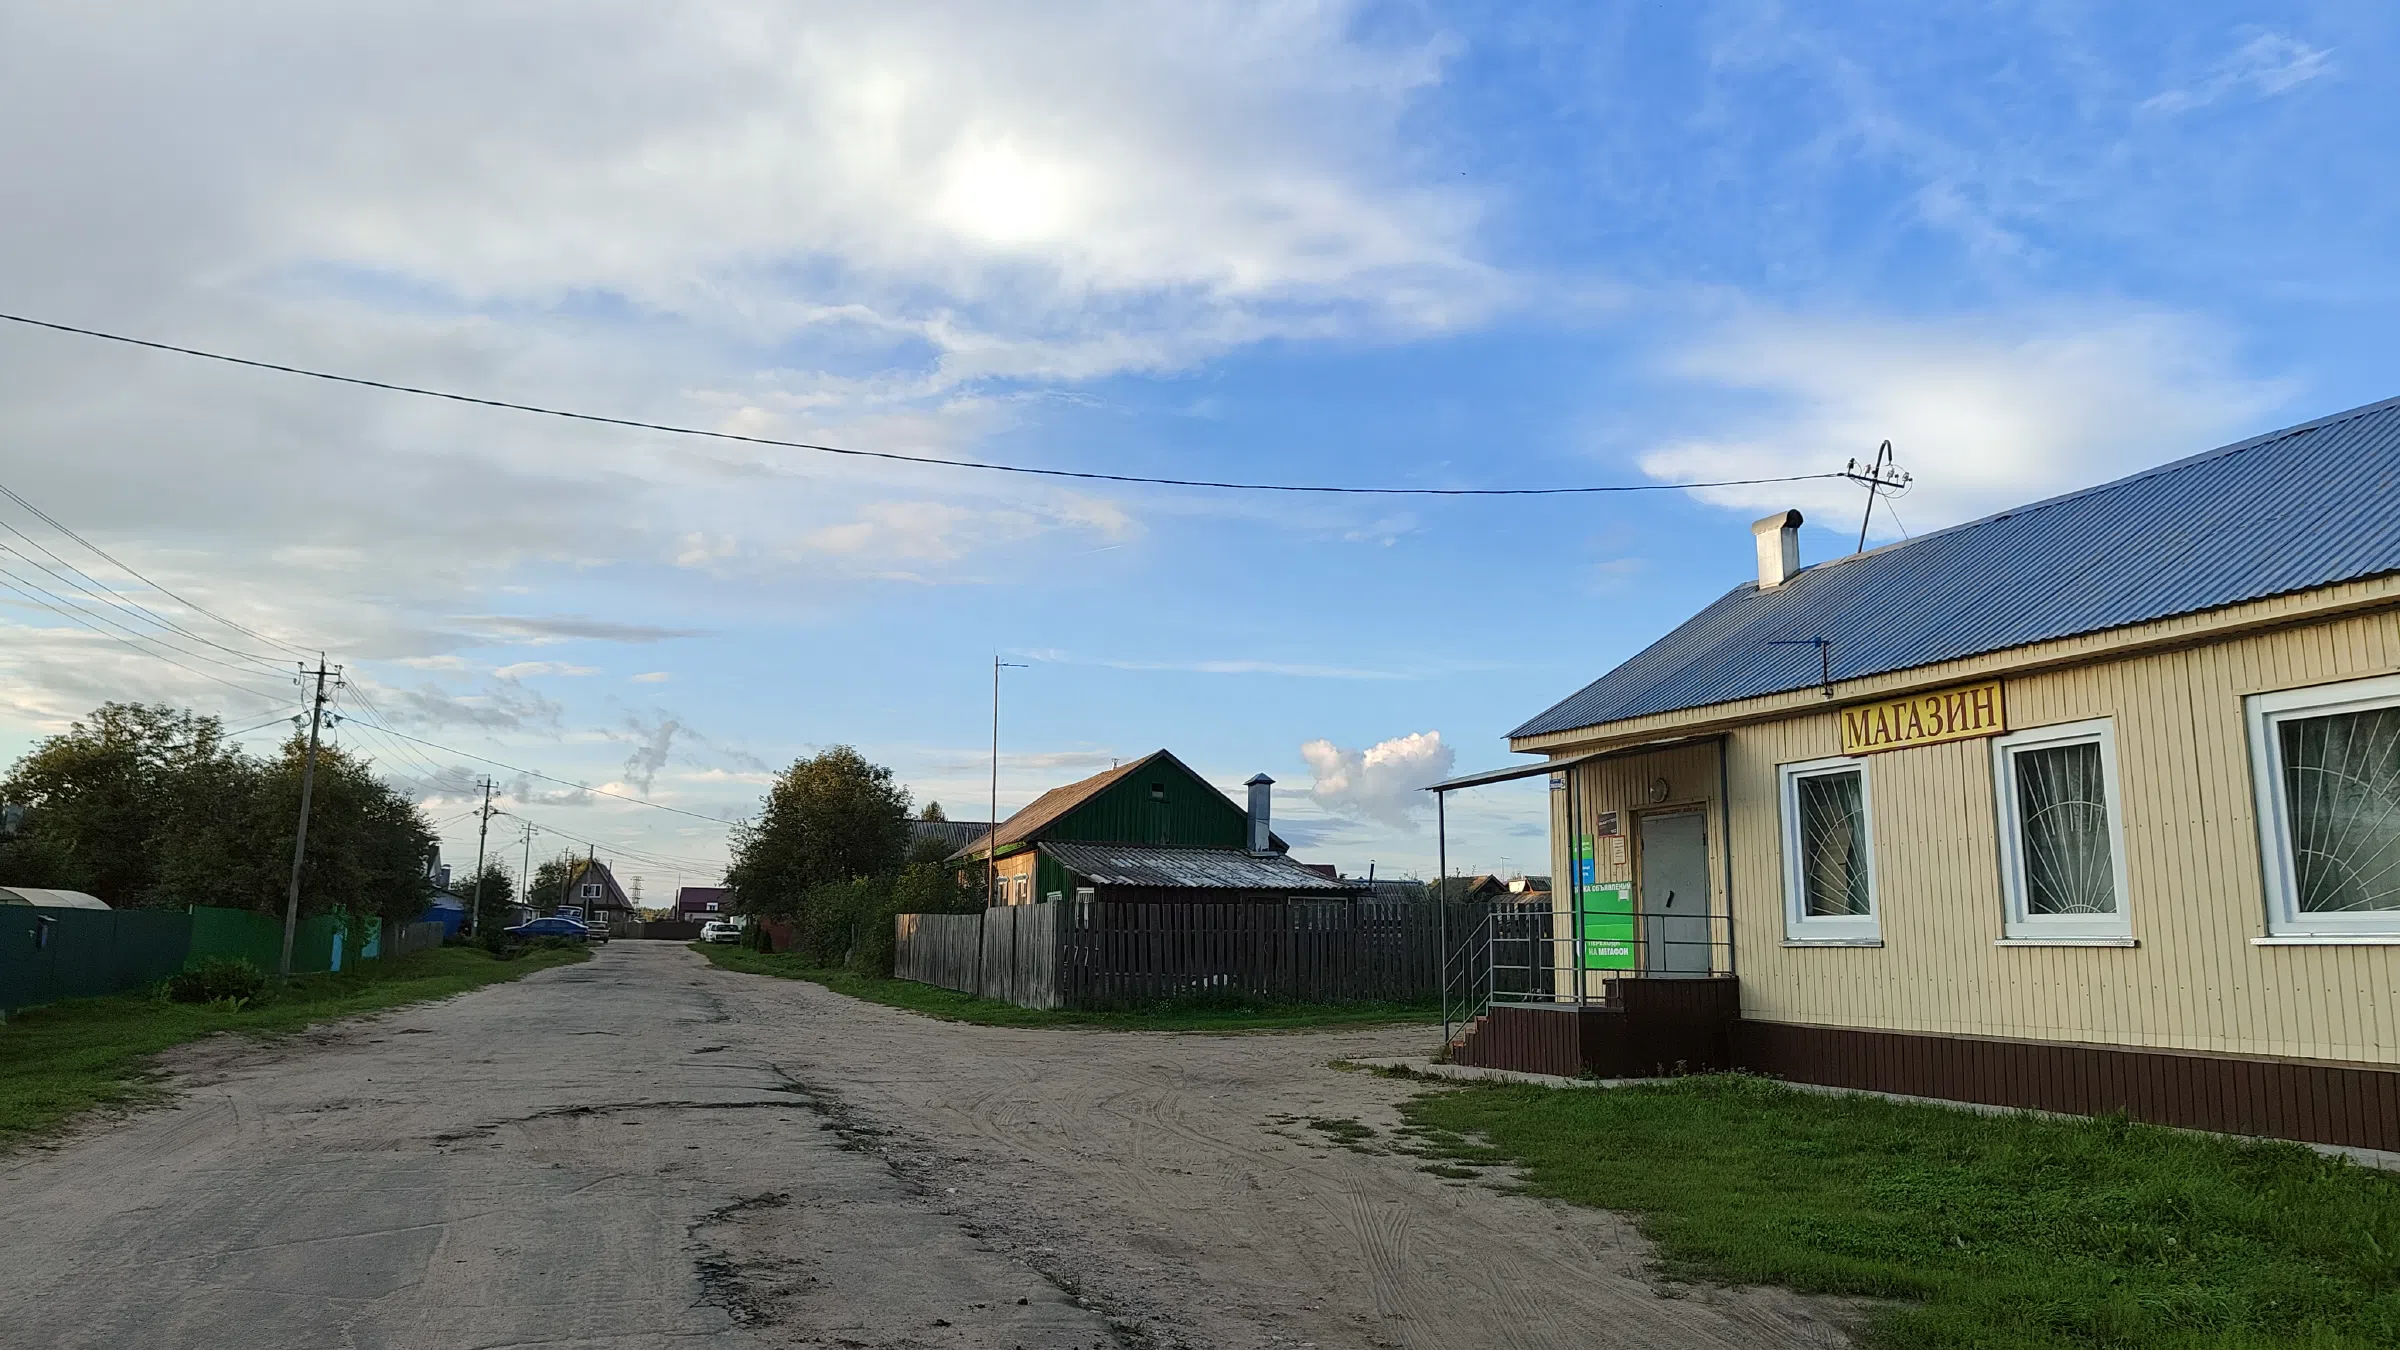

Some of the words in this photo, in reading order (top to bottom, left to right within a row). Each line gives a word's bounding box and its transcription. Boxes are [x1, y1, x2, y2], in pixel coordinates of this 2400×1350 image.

[1845, 686, 1997, 748] МАГАЗИН
[1588, 948, 1598, 956] НА
[1598, 947, 1629, 956] МЕГАФОН
